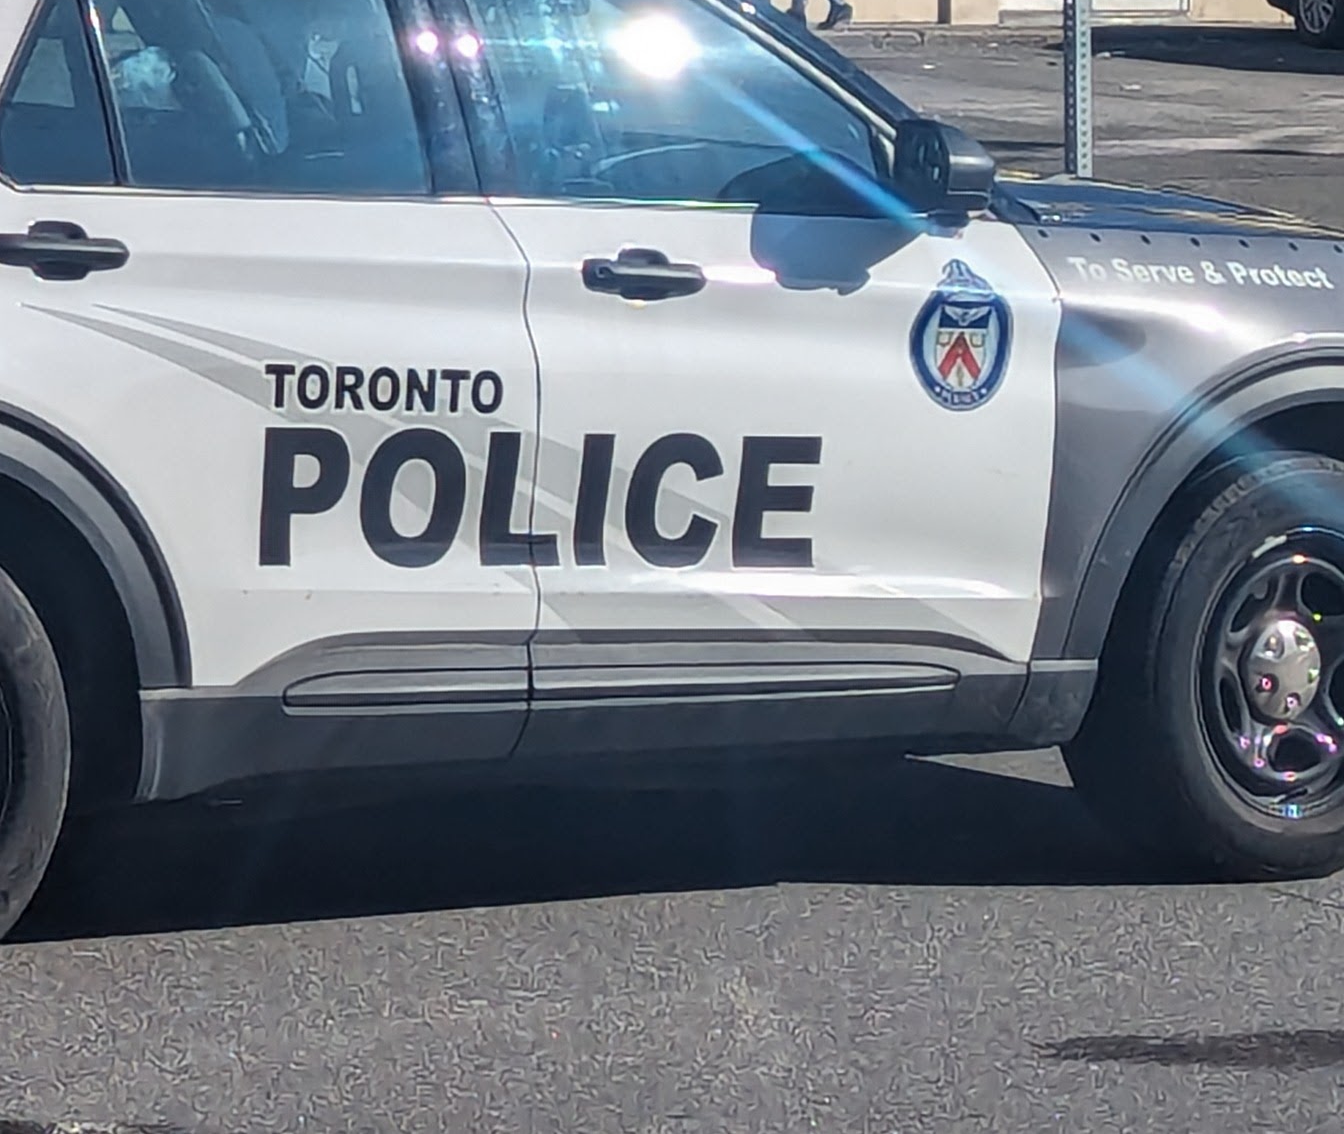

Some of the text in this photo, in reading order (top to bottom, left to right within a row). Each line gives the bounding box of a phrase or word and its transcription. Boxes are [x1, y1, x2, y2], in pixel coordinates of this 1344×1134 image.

[1068, 256, 1336, 291] To Serve & Protect
[264, 363, 504, 415] TORONTO
[258, 425, 823, 569] POLICE
